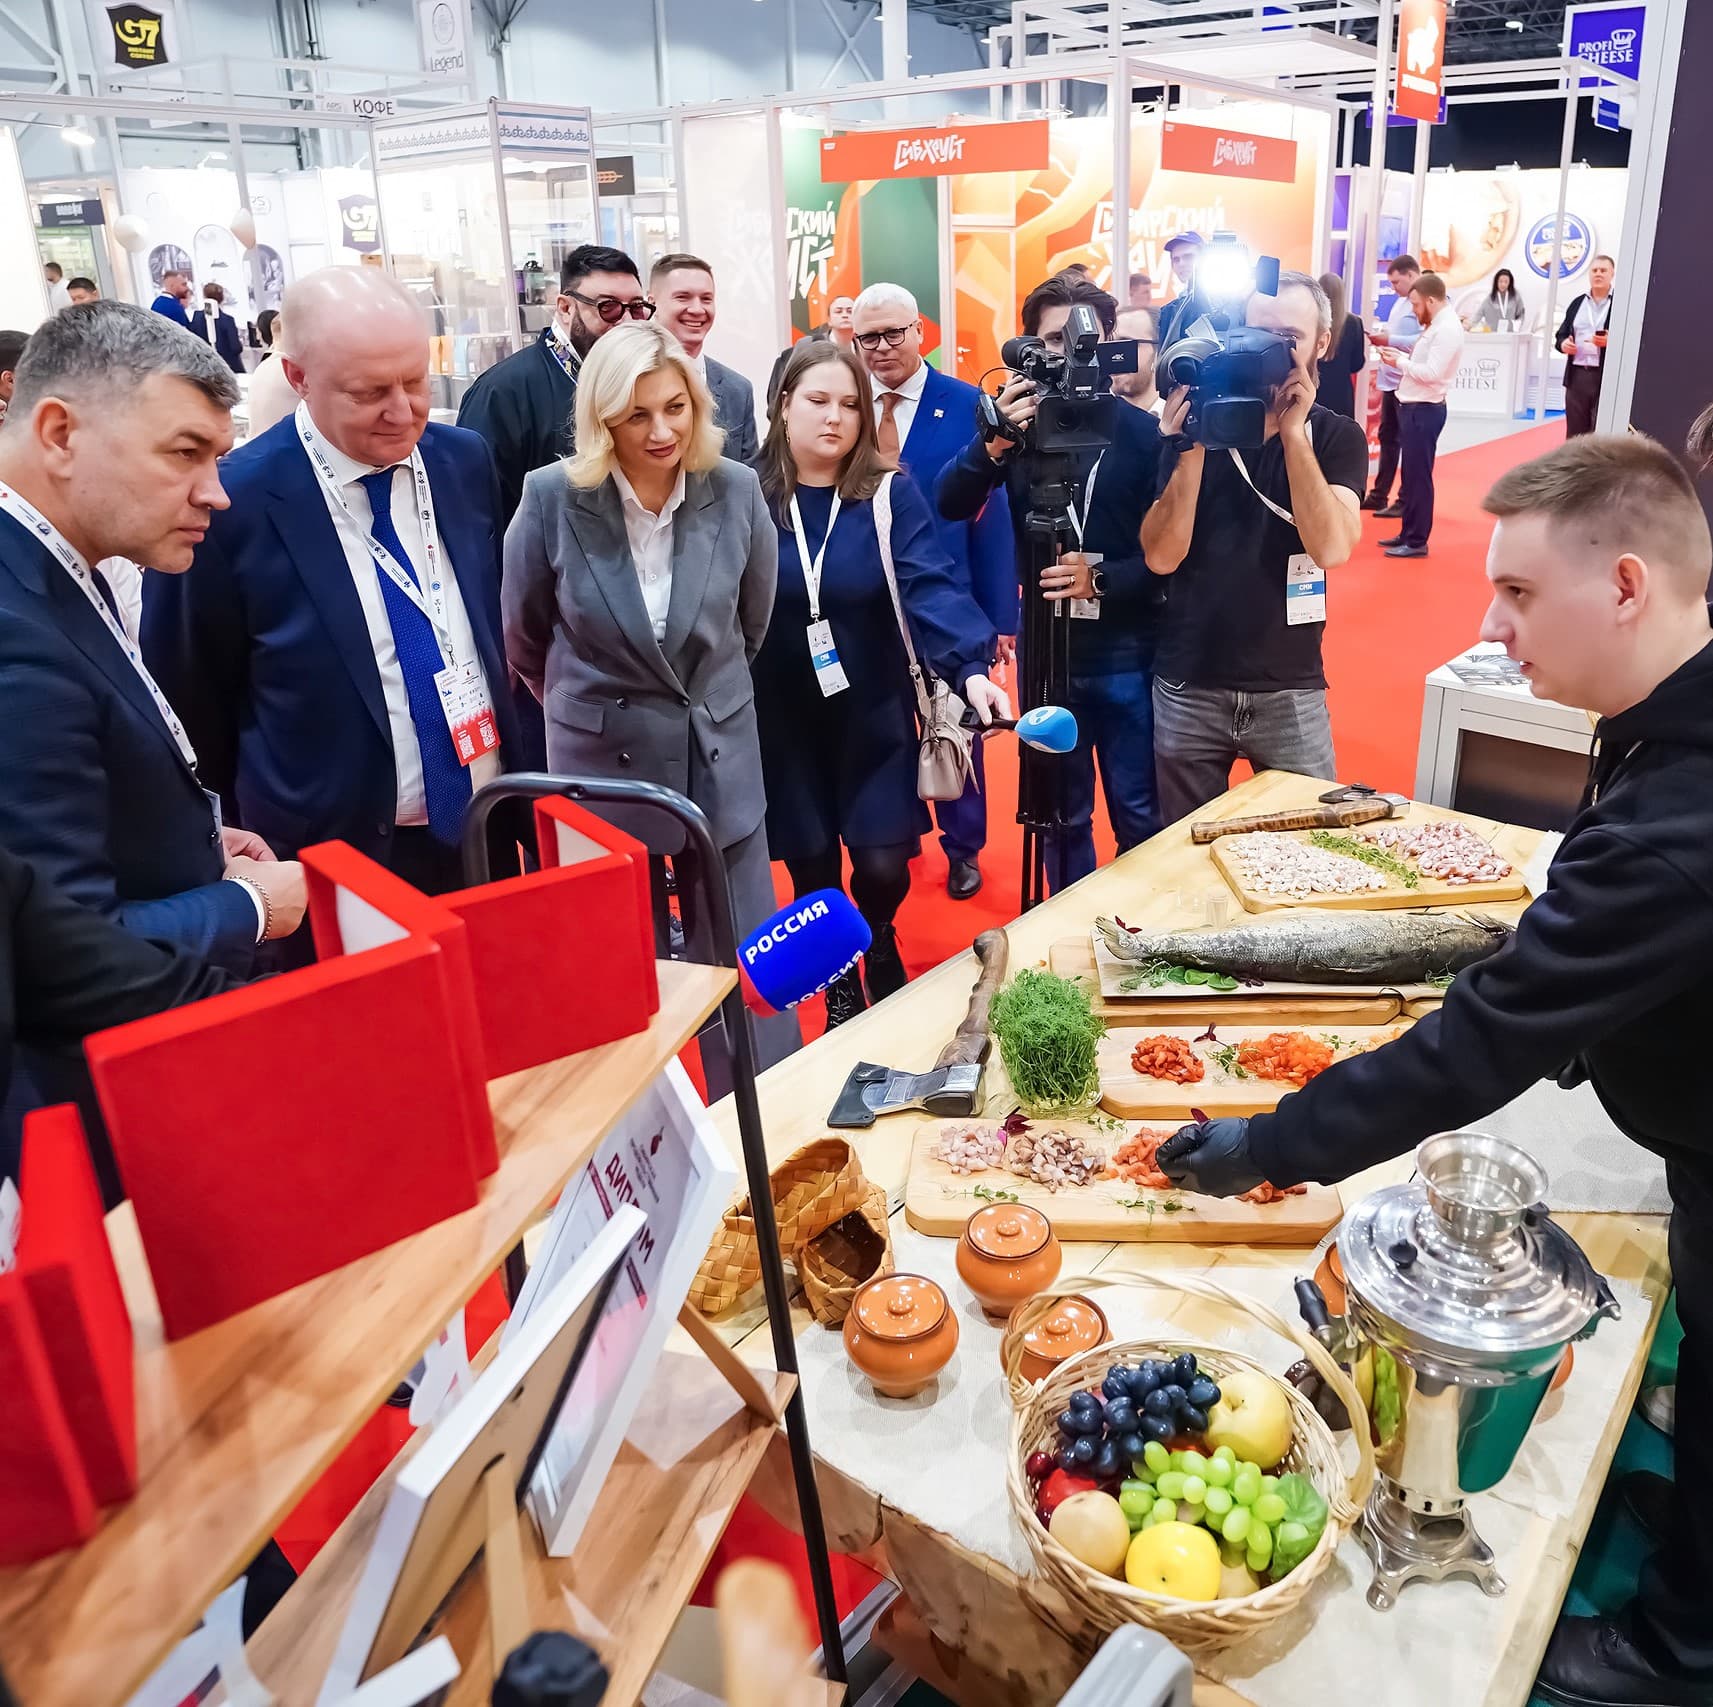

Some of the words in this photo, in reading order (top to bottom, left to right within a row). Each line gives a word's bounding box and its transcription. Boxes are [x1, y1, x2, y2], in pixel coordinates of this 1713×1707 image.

[1578, 40, 1612, 53] PROFI
[430, 50, 464, 73] Legend
[353, 99, 395, 115] КОФЕ
[1455, 377, 1497, 390] HEESE
[745, 899, 829, 965] РОССИЯ
